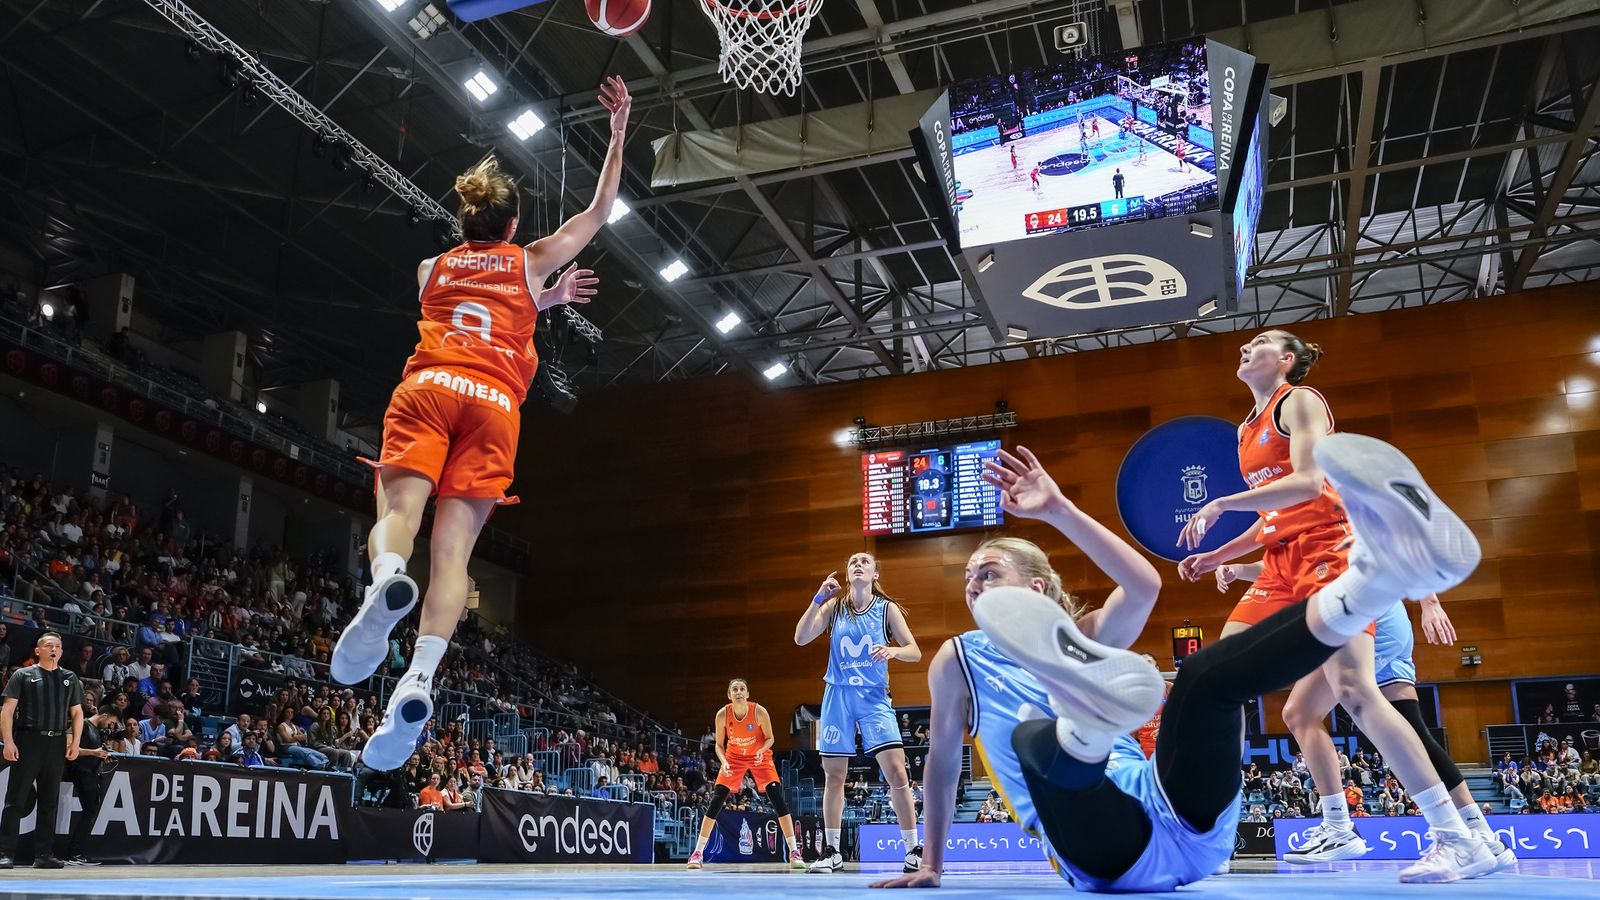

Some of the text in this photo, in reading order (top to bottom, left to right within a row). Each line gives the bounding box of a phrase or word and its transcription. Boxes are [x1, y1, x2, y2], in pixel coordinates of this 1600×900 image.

[1222, 66, 1236, 112] COPA
[1219, 122, 1233, 171] REINA
[933, 120, 948, 162] COPA
[944, 169, 957, 217] REINA
[1048, 213, 1062, 225] 24
[1073, 207, 1098, 222] 19.5
[1111, 204, 1118, 215] 6
[446, 253, 515, 274] QUERALT
[1159, 278, 1177, 296] FEB
[417, 369, 511, 413] PAMESA
[913, 457, 926, 468] 24
[937, 455, 945, 466] 6
[918, 478, 939, 490] 19.3
[941, 509, 947, 518] 2
[839, 659, 873, 672] Estudiantes
[825, 726, 839, 744] hp
[740, 748, 747, 756] 7
[150, 773, 184, 803] DE
[191, 775, 339, 840] REINA
[148, 807, 185, 837] LA
[518, 805, 631, 855] endesa
